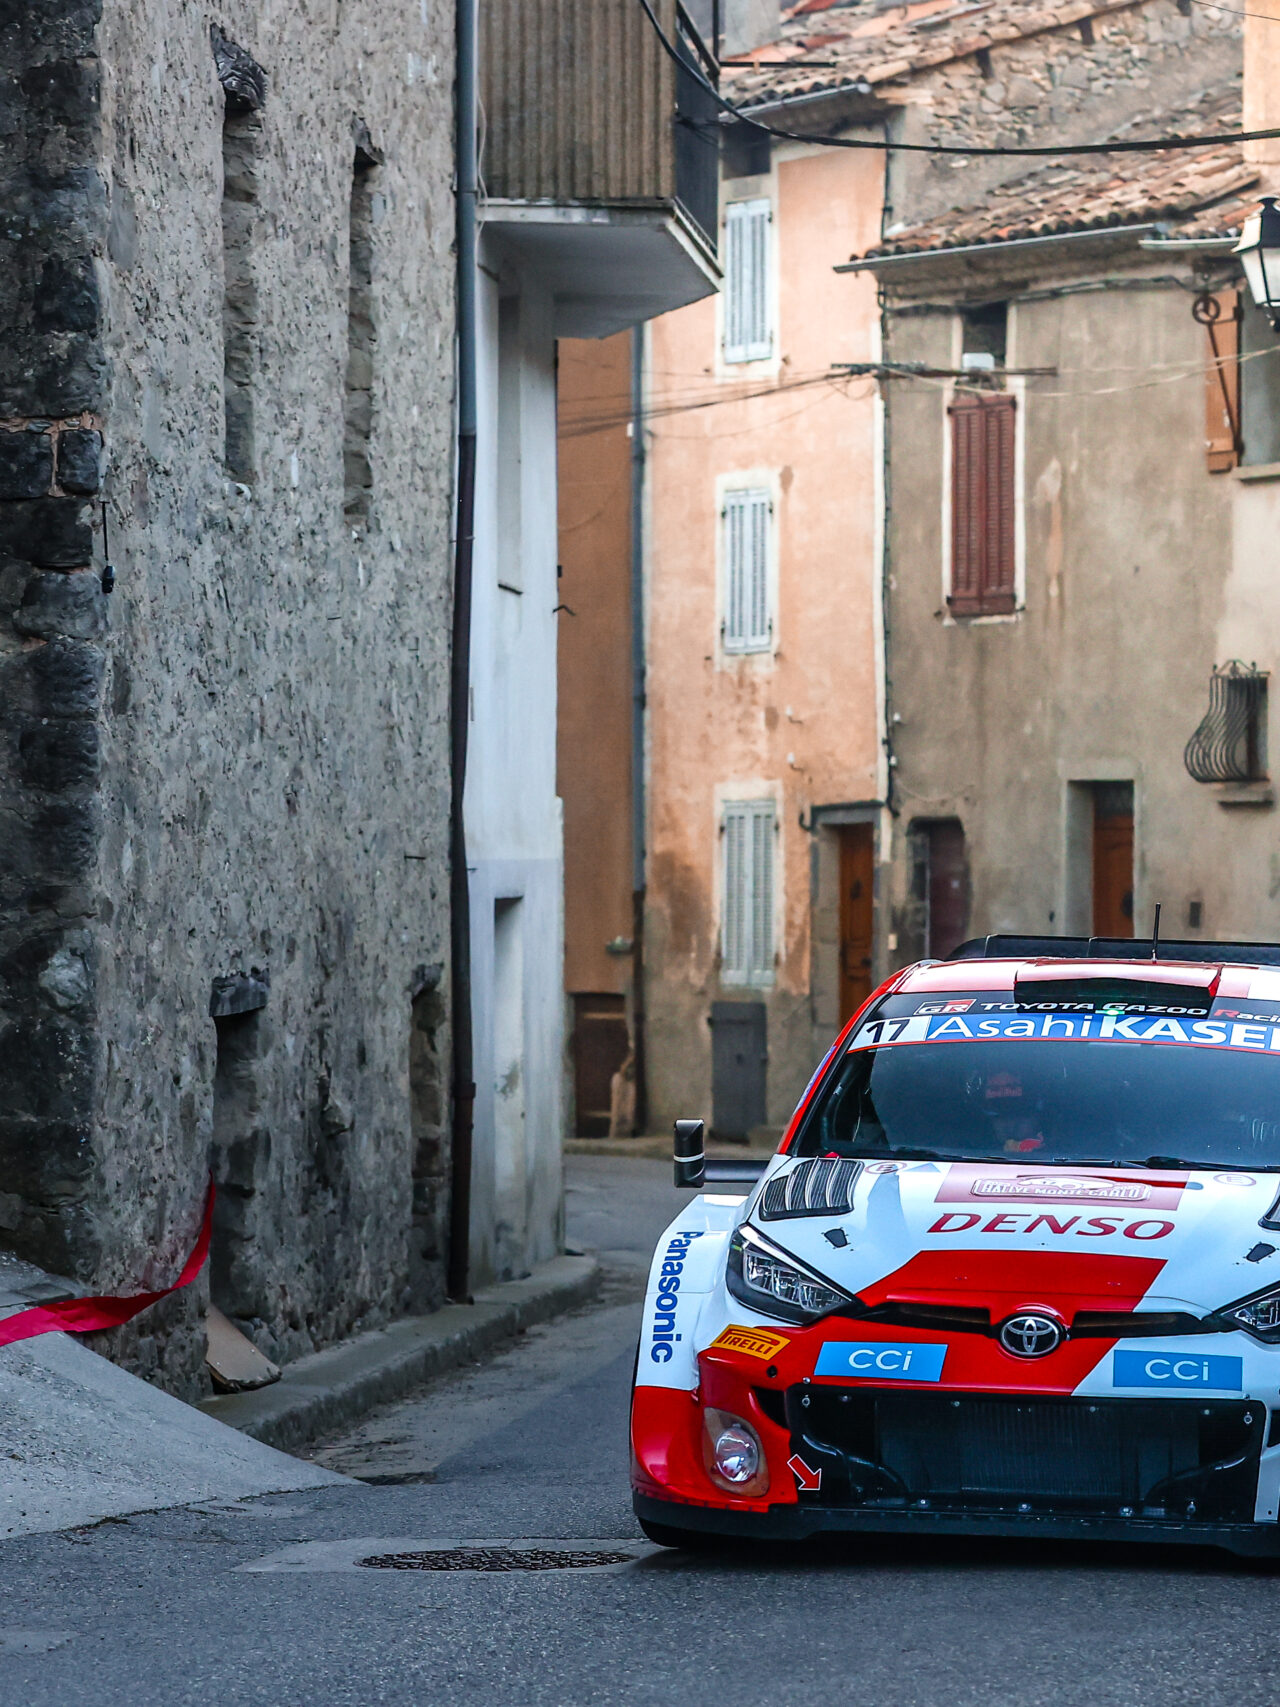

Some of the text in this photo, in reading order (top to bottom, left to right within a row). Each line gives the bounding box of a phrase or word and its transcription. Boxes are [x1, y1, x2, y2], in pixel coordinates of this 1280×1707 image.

[917, 1002, 970, 1014] GR
[980, 1002, 1094, 1011] TOYOTA
[1102, 1002, 1208, 1016] GAZOO
[866, 1018, 911, 1044] 17
[982, 1181, 1141, 1198] RALLYE MONTE CARLO
[926, 1212, 1176, 1240] DENSO
[650, 1231, 705, 1363] Panasonic
[717, 1328, 781, 1355] PIRELLI
[848, 1349, 913, 1371] CCi
[1145, 1359, 1209, 1381] CCi
